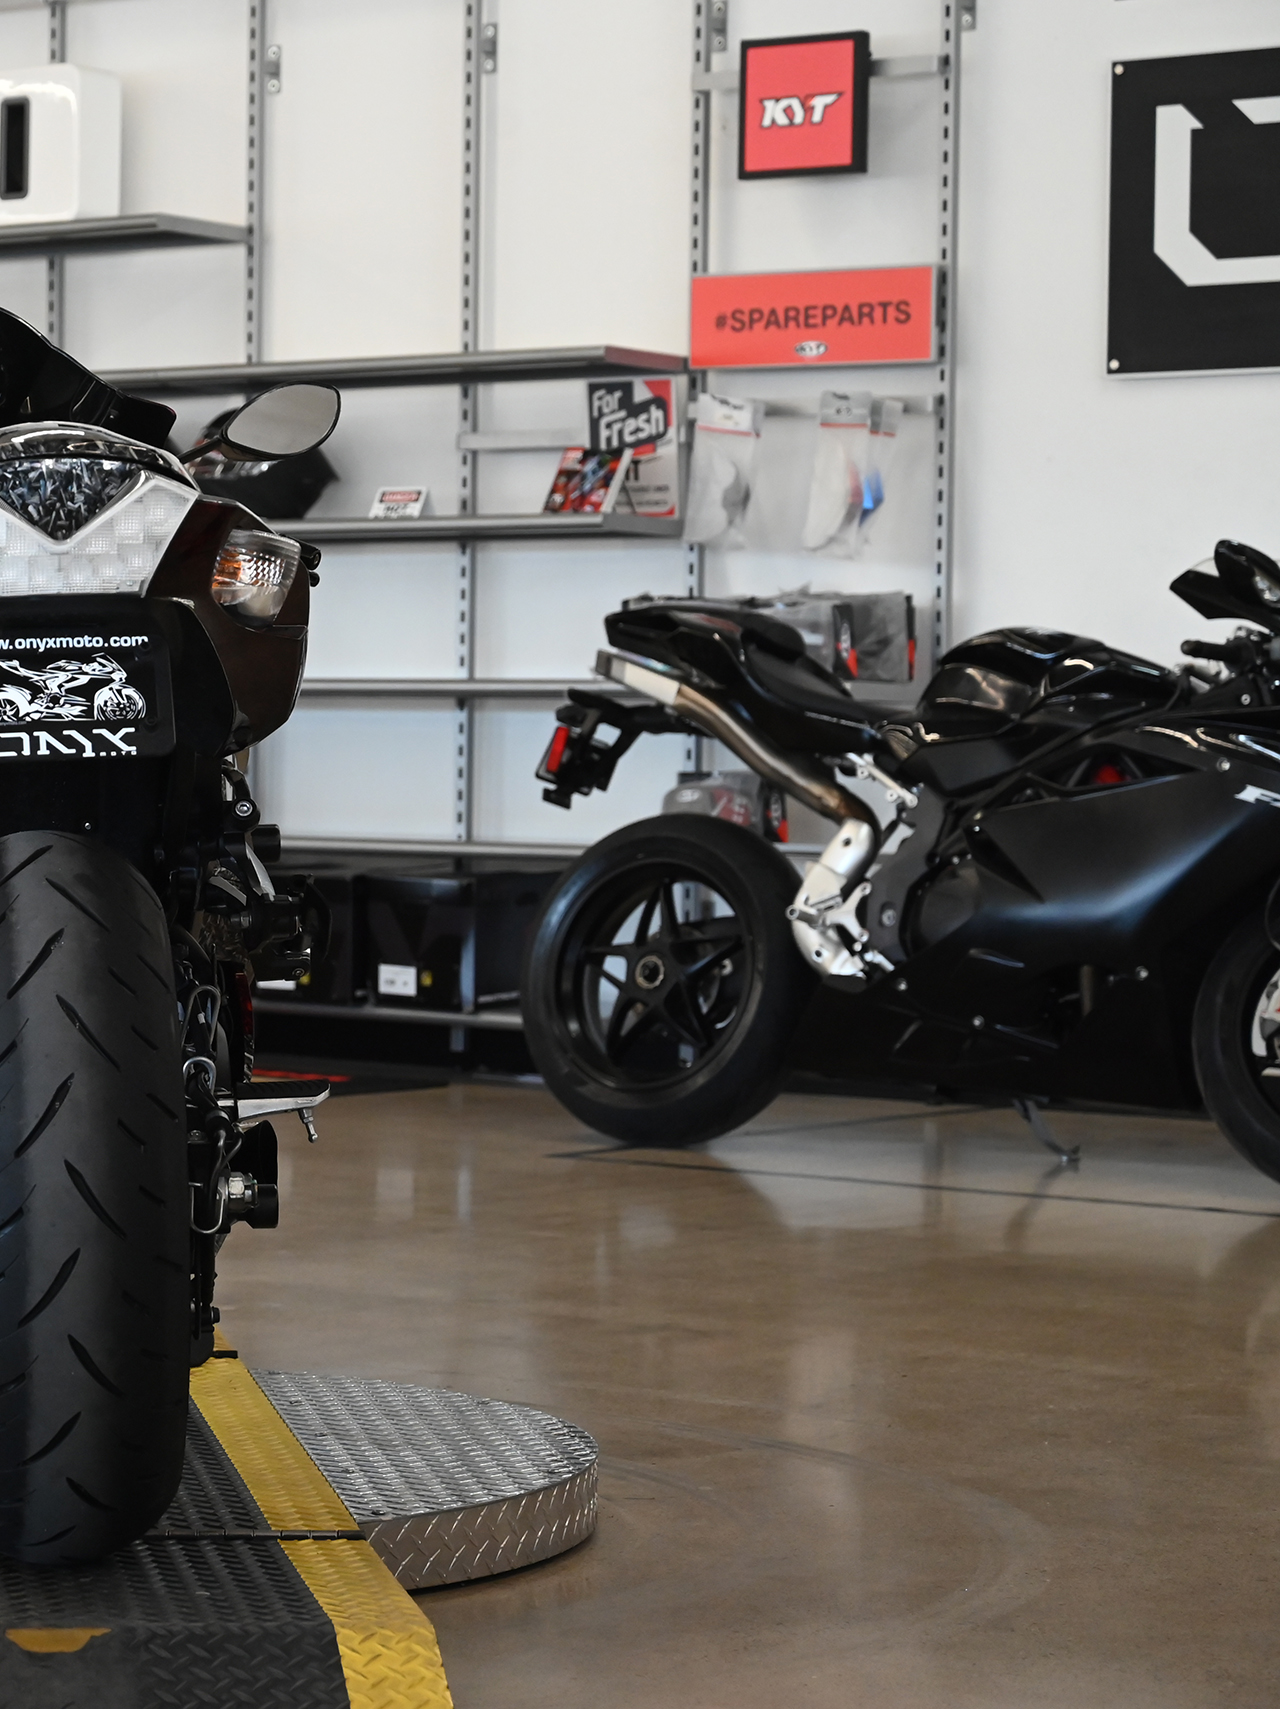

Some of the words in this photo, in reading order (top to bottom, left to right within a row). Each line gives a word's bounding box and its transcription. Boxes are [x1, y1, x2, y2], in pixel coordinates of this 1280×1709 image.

[760, 91, 844, 128] KYT
[715, 300, 911, 333] #SPAREPARTS
[592, 389, 623, 418] For
[599, 404, 666, 452] Fresh
